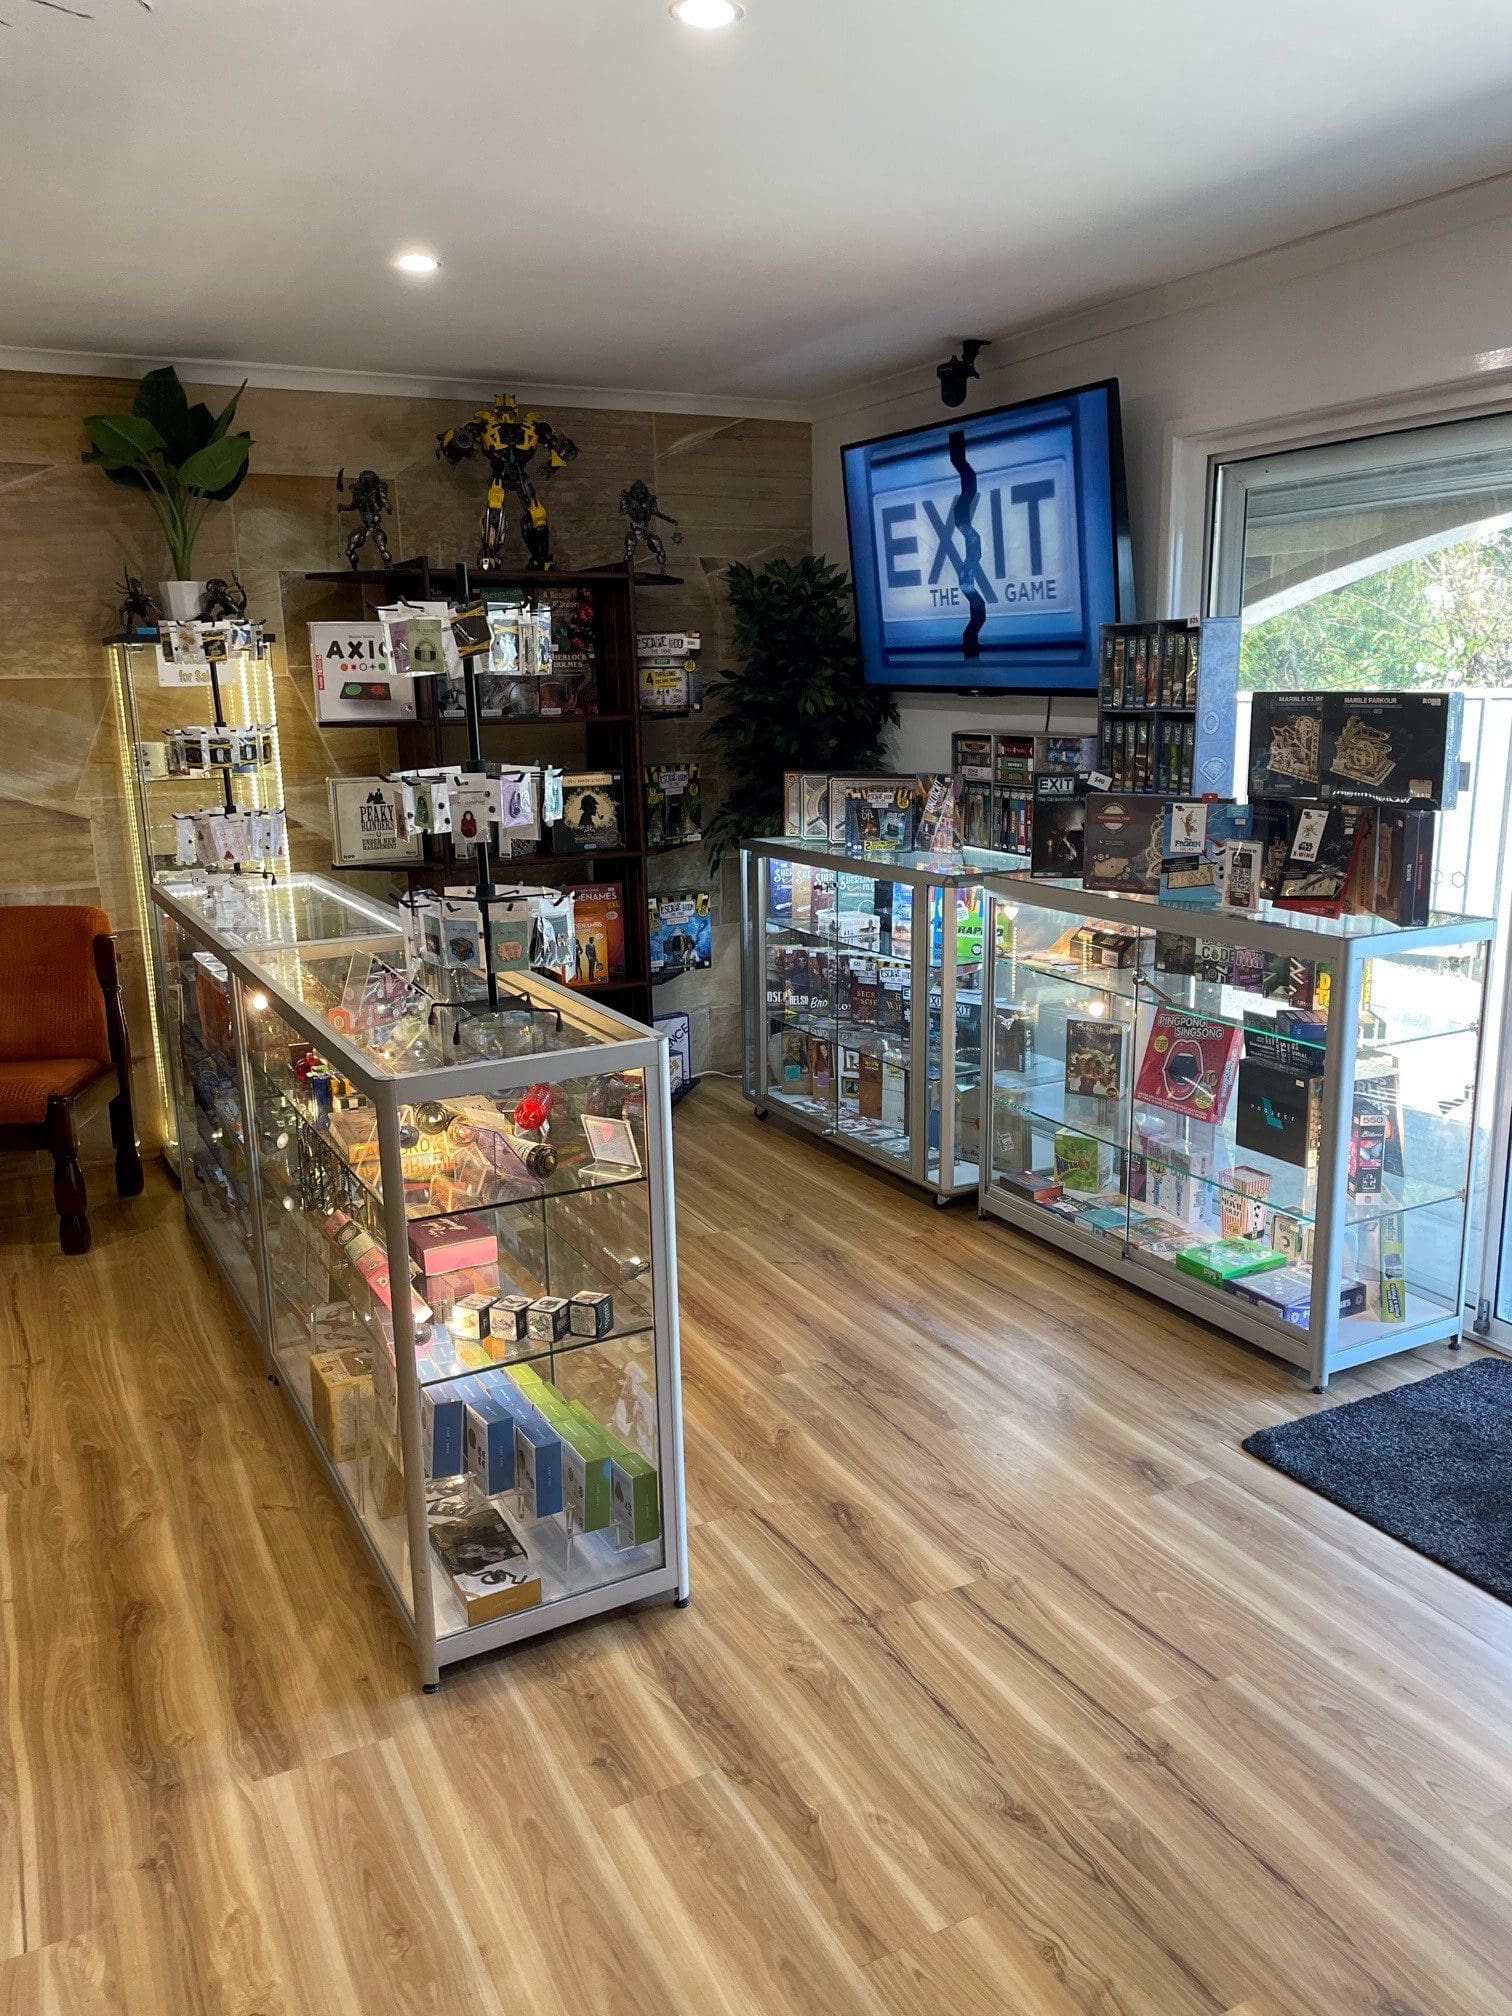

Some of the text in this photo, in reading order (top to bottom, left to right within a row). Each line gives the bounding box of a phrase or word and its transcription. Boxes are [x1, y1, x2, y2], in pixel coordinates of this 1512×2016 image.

[882, 478, 1056, 604] EXIT
[929, 579, 1057, 607] THE GAME
[552, 652, 587, 661] HERLOCK
[178, 669, 210, 683] for Sal
[646, 672, 654, 685] 4
[1368, 697, 1398, 705] PARKOUR
[1039, 778, 1073, 793] EXIT
[359, 804, 394, 821] PEAKY
[361, 820, 395, 832] BLINDERS
[1293, 851, 1315, 859] X-WING
[577, 891, 618, 902] ENAMES
[956, 1004, 970, 1017] XIT
[669, 1022, 689, 1049] NCE
[1175, 1027, 1224, 1039] SINGSONG
